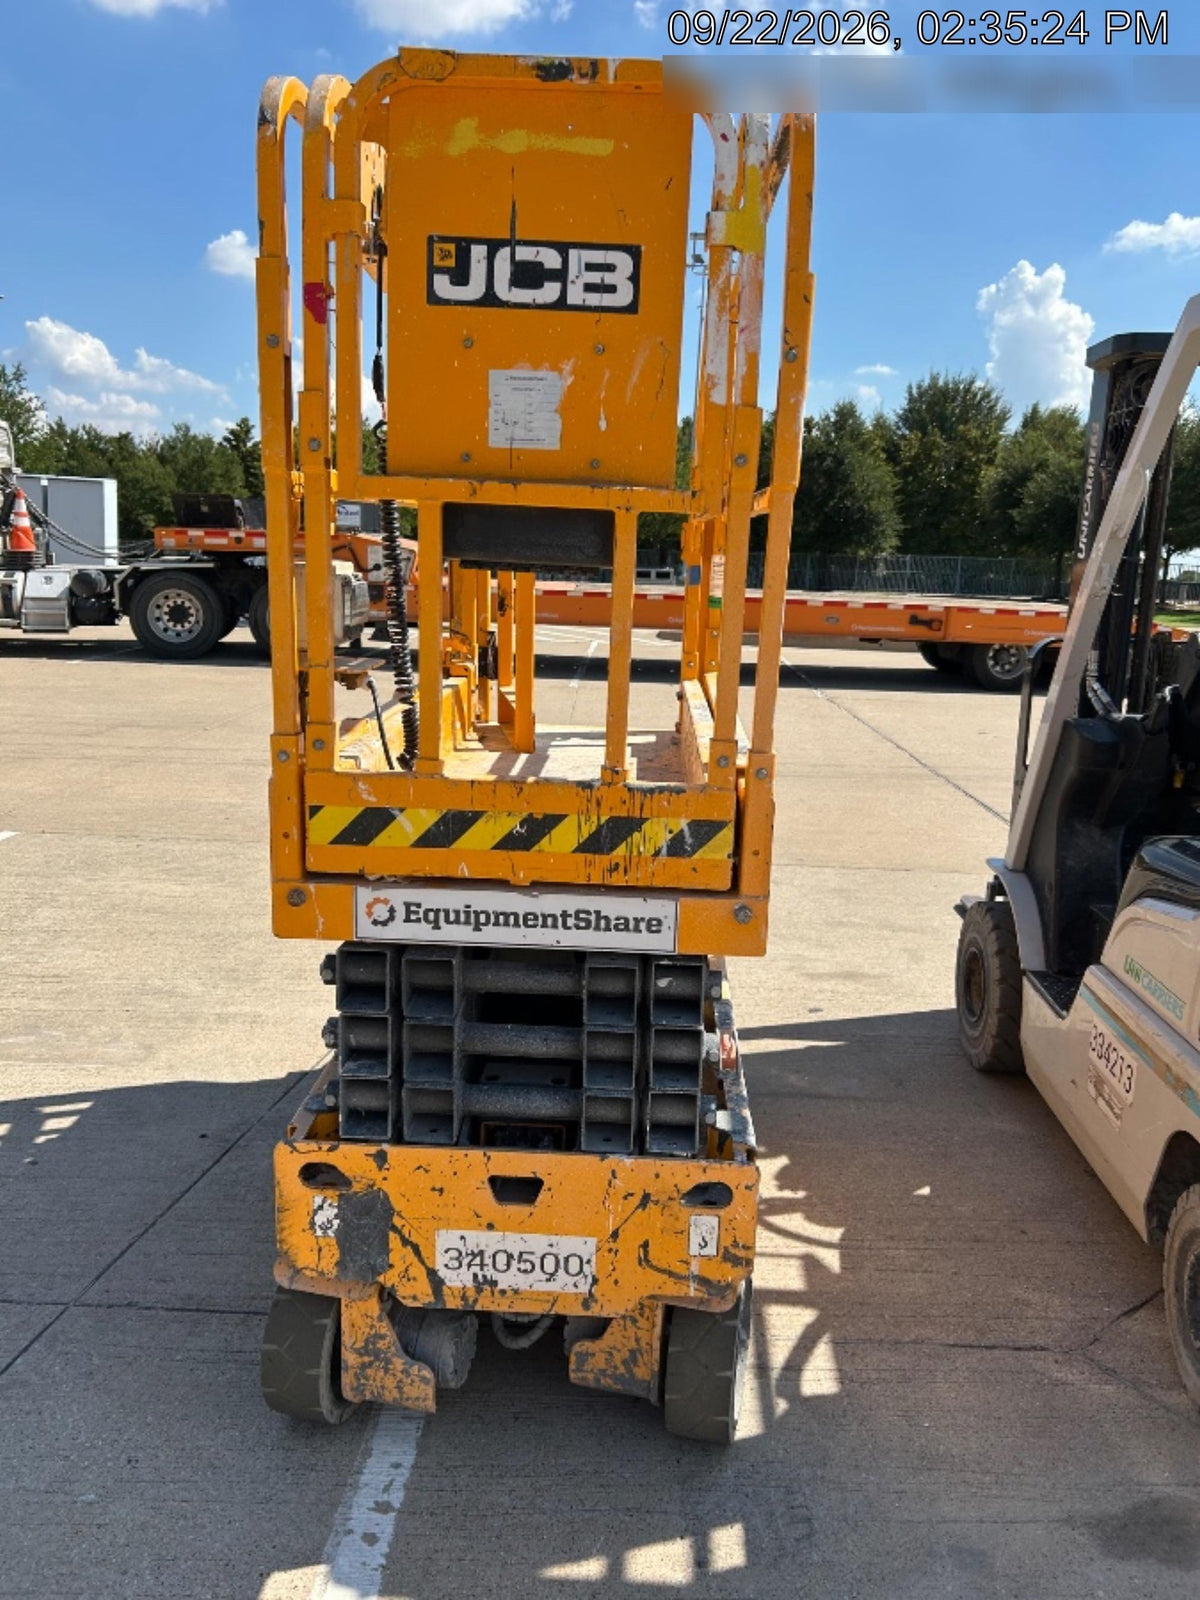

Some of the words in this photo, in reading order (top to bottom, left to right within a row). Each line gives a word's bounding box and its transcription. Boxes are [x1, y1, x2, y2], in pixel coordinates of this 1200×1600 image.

[433, 243, 634, 307] JCB
[402, 900, 663, 933] EquipmentShare
[443, 1247, 584, 1277] 340500
